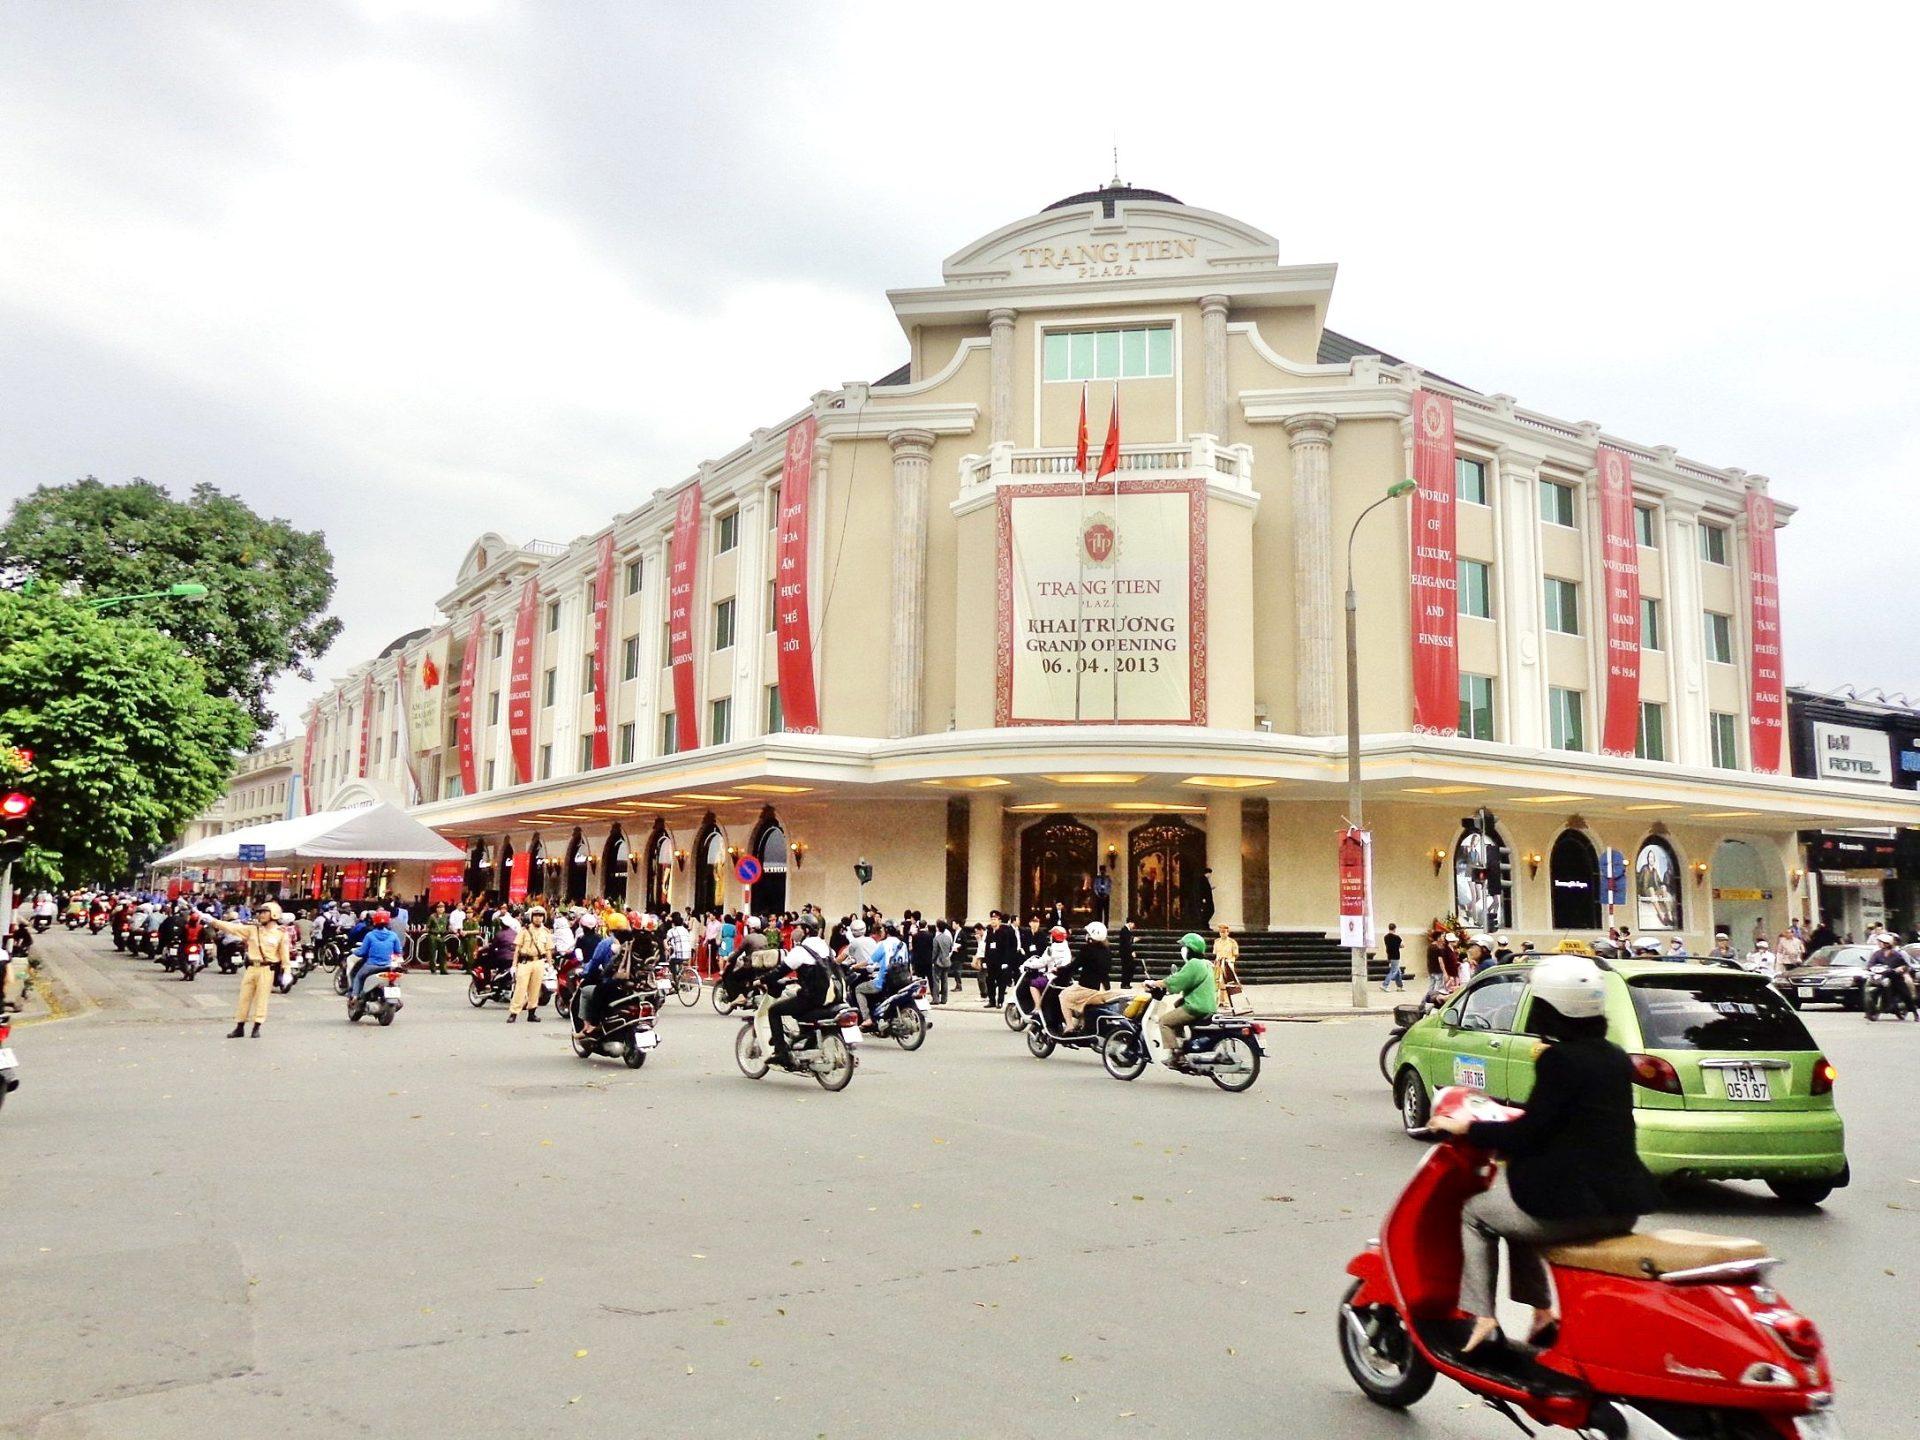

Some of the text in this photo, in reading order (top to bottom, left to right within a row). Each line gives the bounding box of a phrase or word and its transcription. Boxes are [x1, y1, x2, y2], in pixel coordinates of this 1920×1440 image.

[1019, 238, 1197, 270] TRANG TIEN
[1078, 264, 1137, 279] PLAZA
[1418, 487, 1449, 504] WORLD
[1427, 519, 1440, 530] OF
[1416, 545, 1452, 562] LUXURY,
[1037, 579, 1162, 597] TRANG TIEN
[1410, 574, 1458, 591] ELEGANCE
[1426, 605, 1444, 617] AND
[1027, 615, 1175, 634] KHAI TRƯƠNG
[1026, 638, 1177, 652] GRAND OPENING
[1418, 632, 1454, 648] FINESSE
[1828, 757, 1881, 774] ROTEL
[1733, 1066, 1757, 1082] 15A
